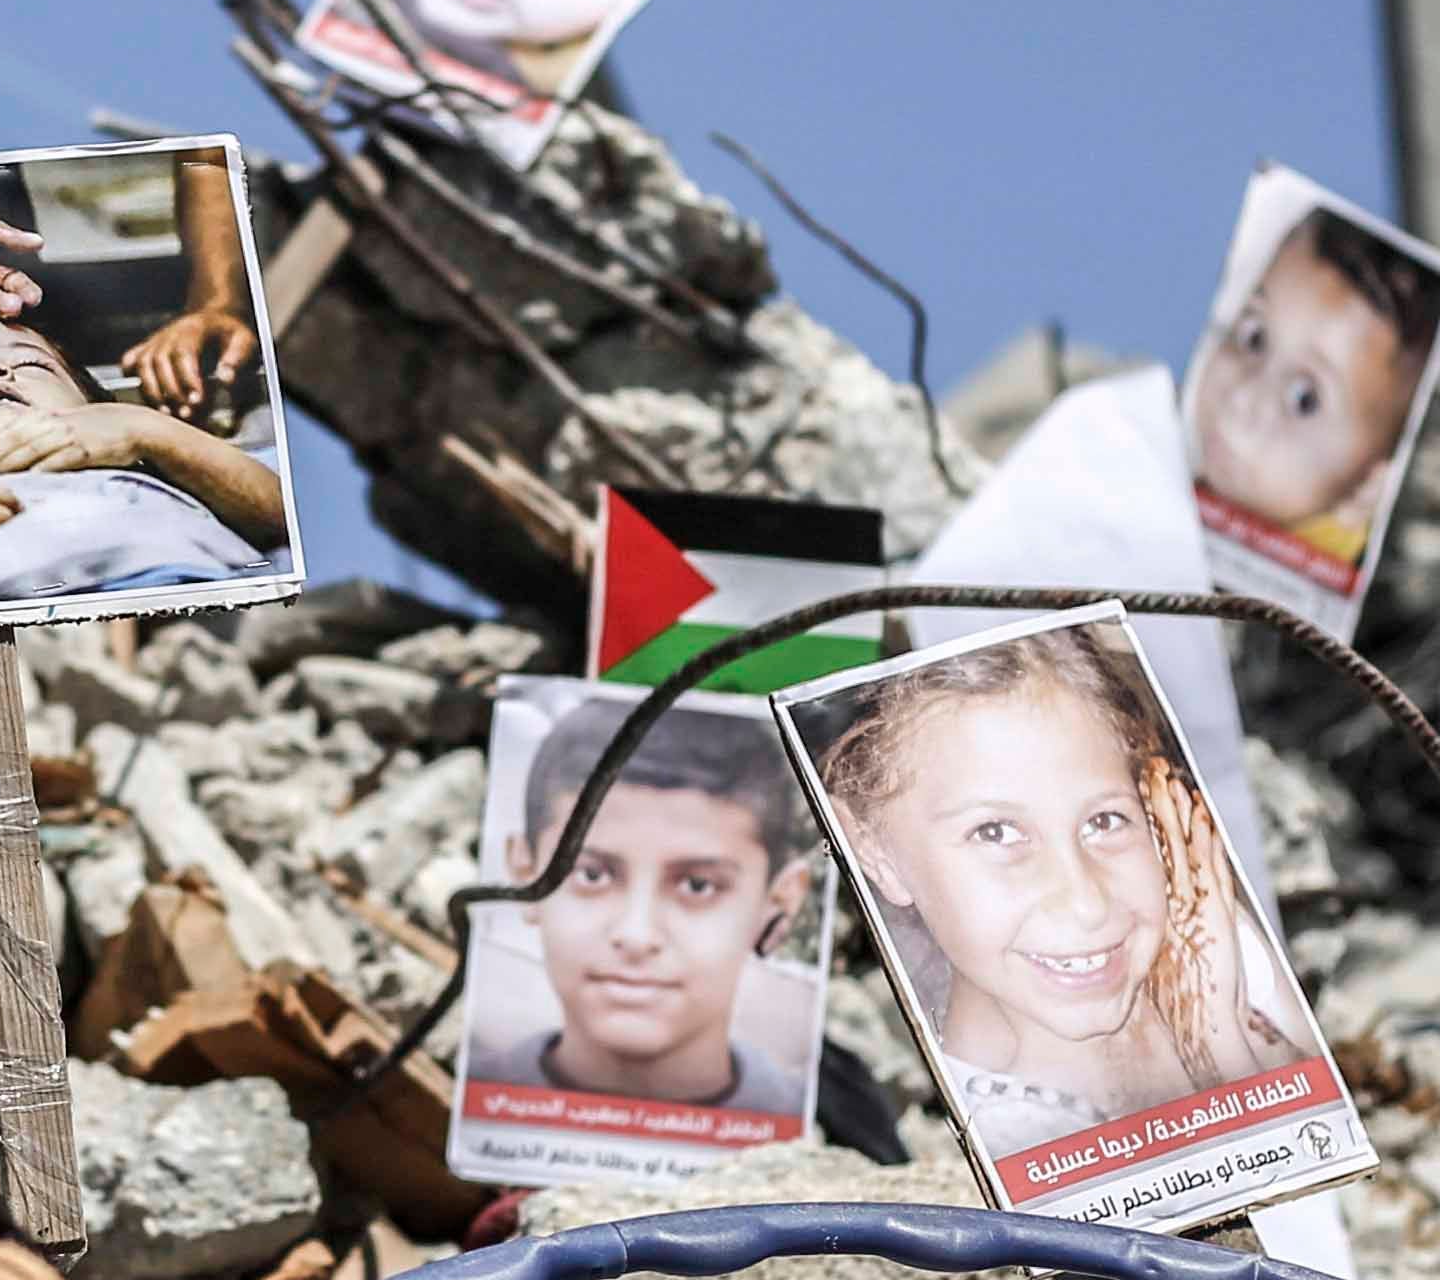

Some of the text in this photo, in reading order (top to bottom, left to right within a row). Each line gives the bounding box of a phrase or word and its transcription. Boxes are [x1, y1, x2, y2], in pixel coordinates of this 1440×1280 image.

[1025, 1072, 1313, 1184] الطفلة الشهيدة/ ديما عسلية
[1056, 1144, 1294, 1223] جمعية لو بطلنا نحلم الخي
